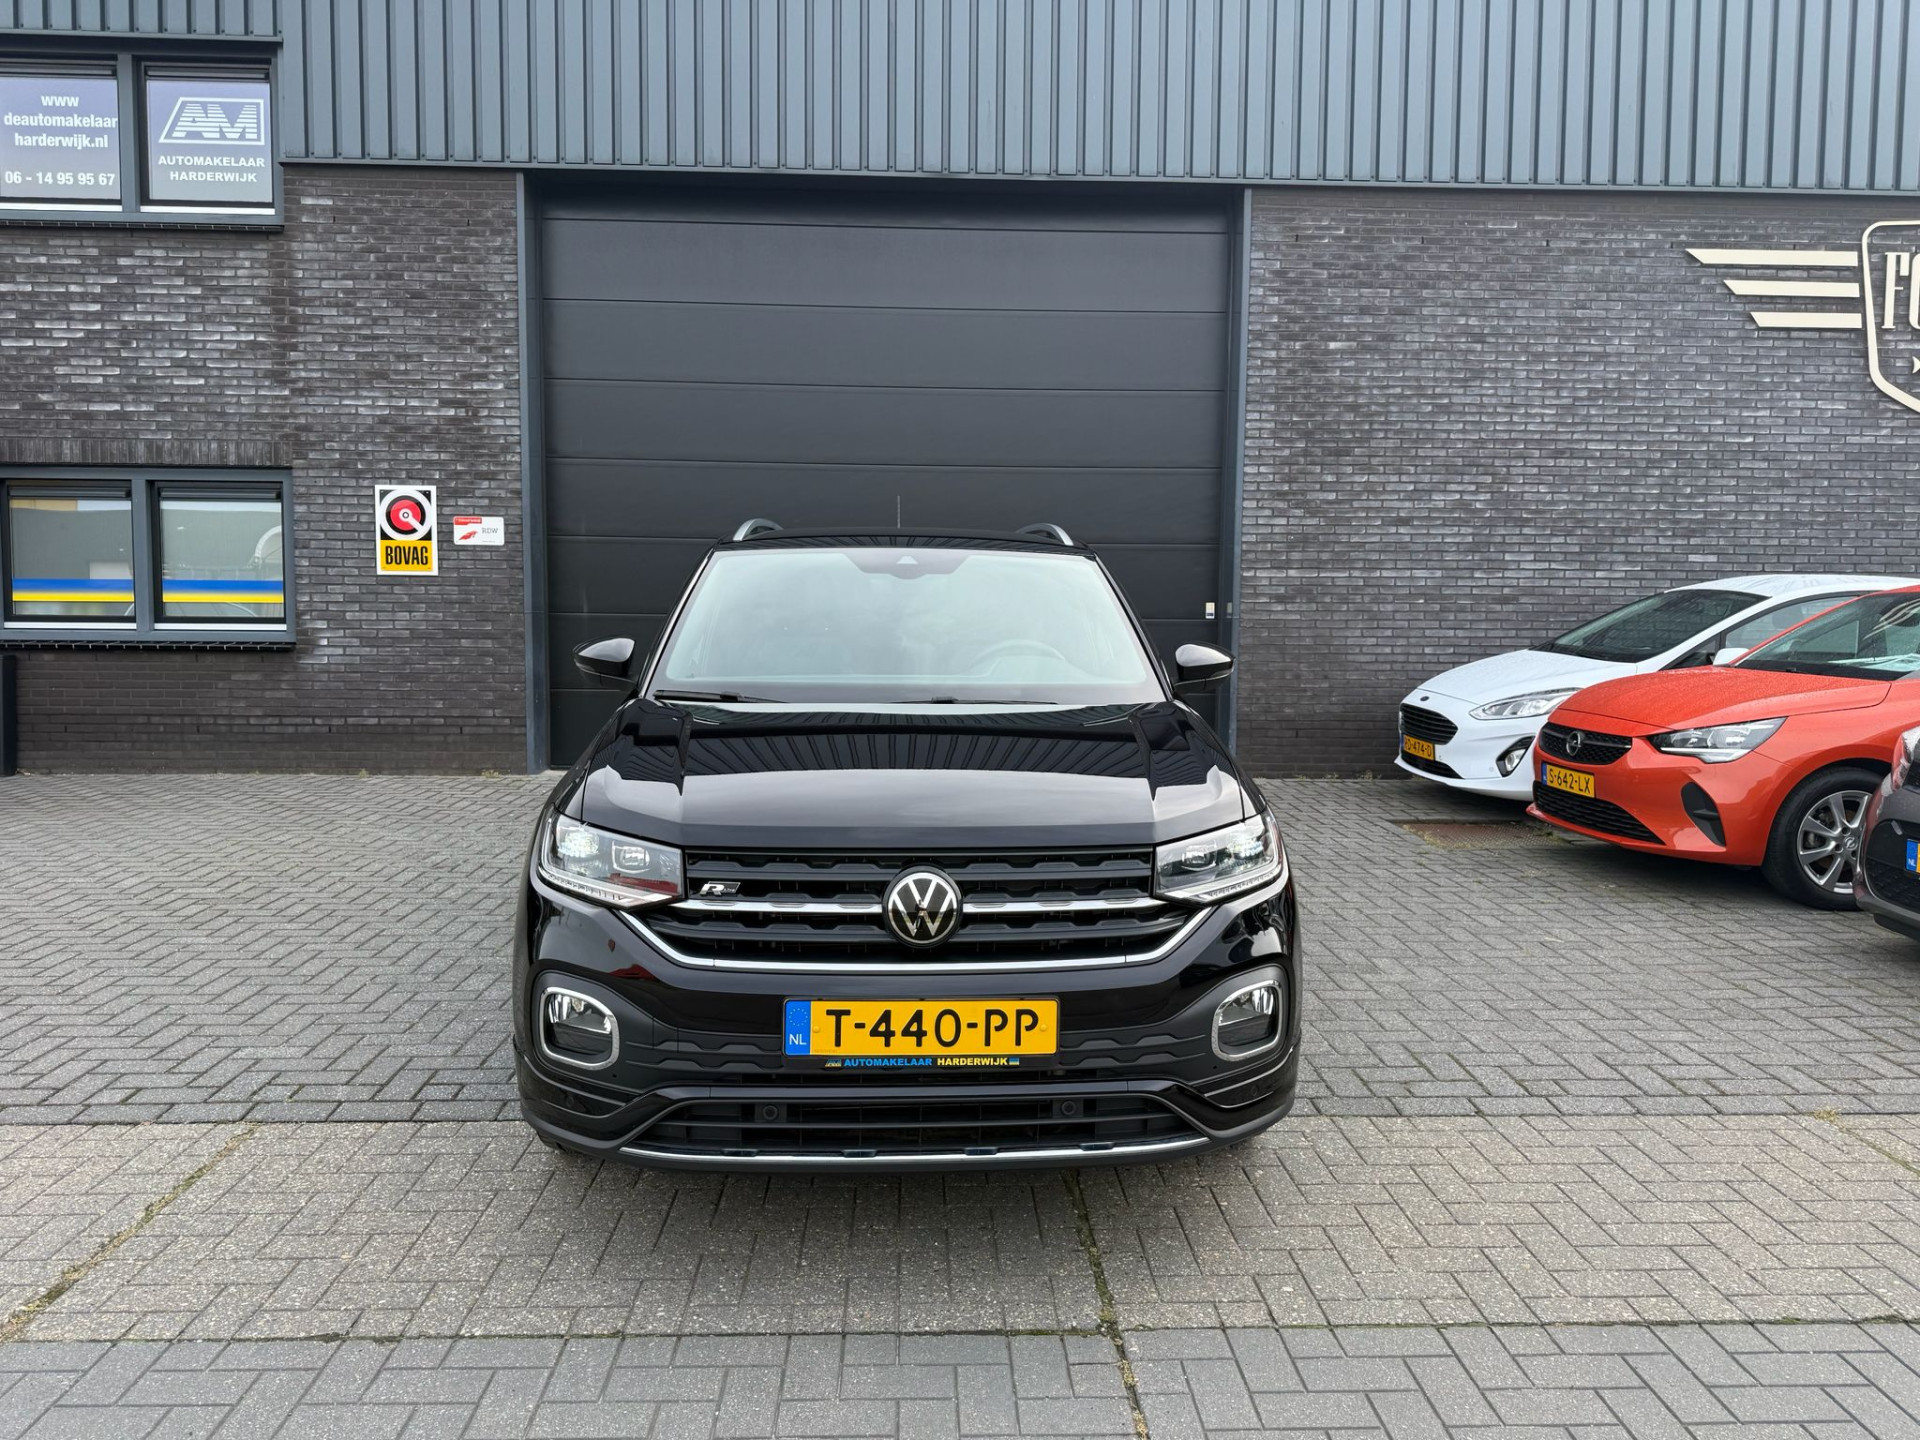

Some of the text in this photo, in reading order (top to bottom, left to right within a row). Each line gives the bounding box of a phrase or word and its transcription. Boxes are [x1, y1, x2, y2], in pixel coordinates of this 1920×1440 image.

[41, 95, 79, 107] www
[3, 112, 119, 128] deautomakelaar
[14, 133, 109, 150] harderwijk.nl
[158, 155, 265, 168] AUTOMAKELAAR
[5, 171, 22, 184] 06
[36, 171, 53, 185] 14
[57, 172, 74, 185] 95
[78, 172, 95, 186] 95
[98, 173, 115, 186] 67
[170, 171, 258, 183] HARDERWIJK
[385, 545, 428, 565] BOVAG
[1549, 768, 1590, 794] S-642-LX
[825, 1009, 1040, 1048] T-440-PP
[789, 1033, 807, 1046] NL
[844, 1058, 932, 1067] AUTOMAKELAAR
[937, 1057, 1008, 1067] HARDERWIJK
